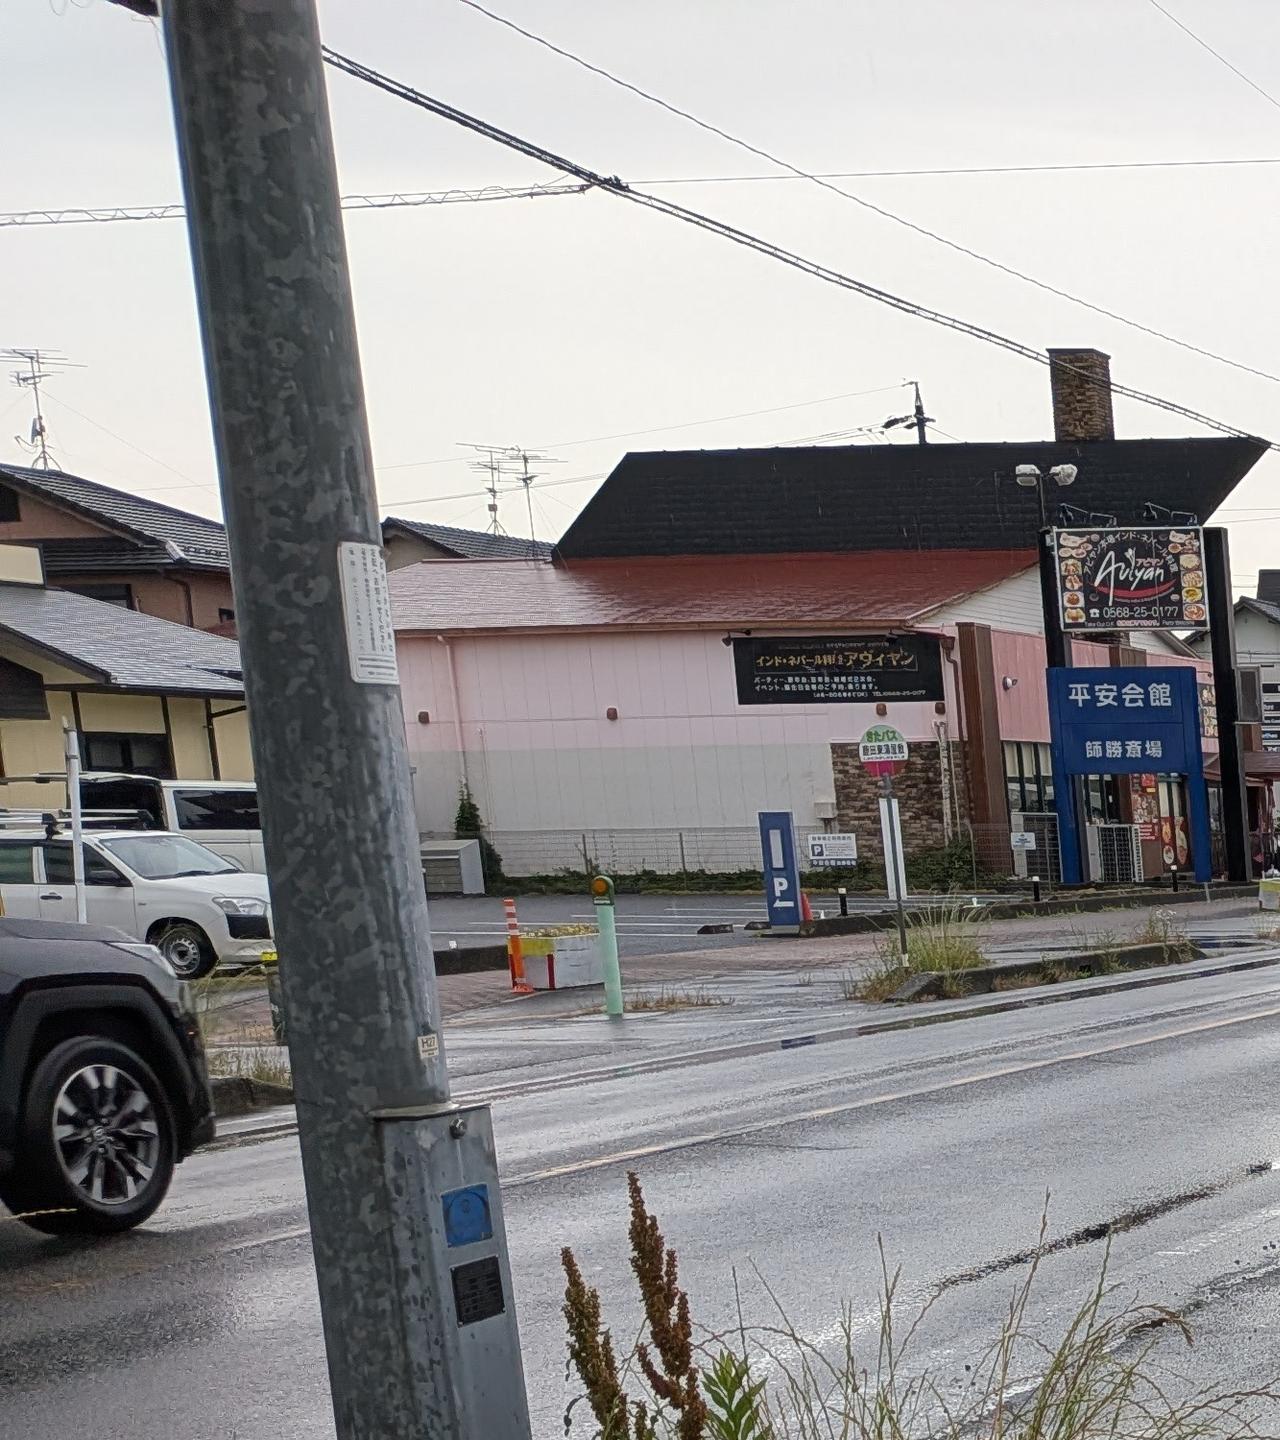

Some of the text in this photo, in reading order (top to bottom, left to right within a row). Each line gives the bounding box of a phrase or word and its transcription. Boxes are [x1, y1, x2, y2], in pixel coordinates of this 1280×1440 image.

[1103, 607, 1178, 618] 0568-25-0177
[1068, 683, 1172, 707] 平安会館
[1085, 740, 1162, 758] 師勝斎場
[773, 877, 788, 897] P
